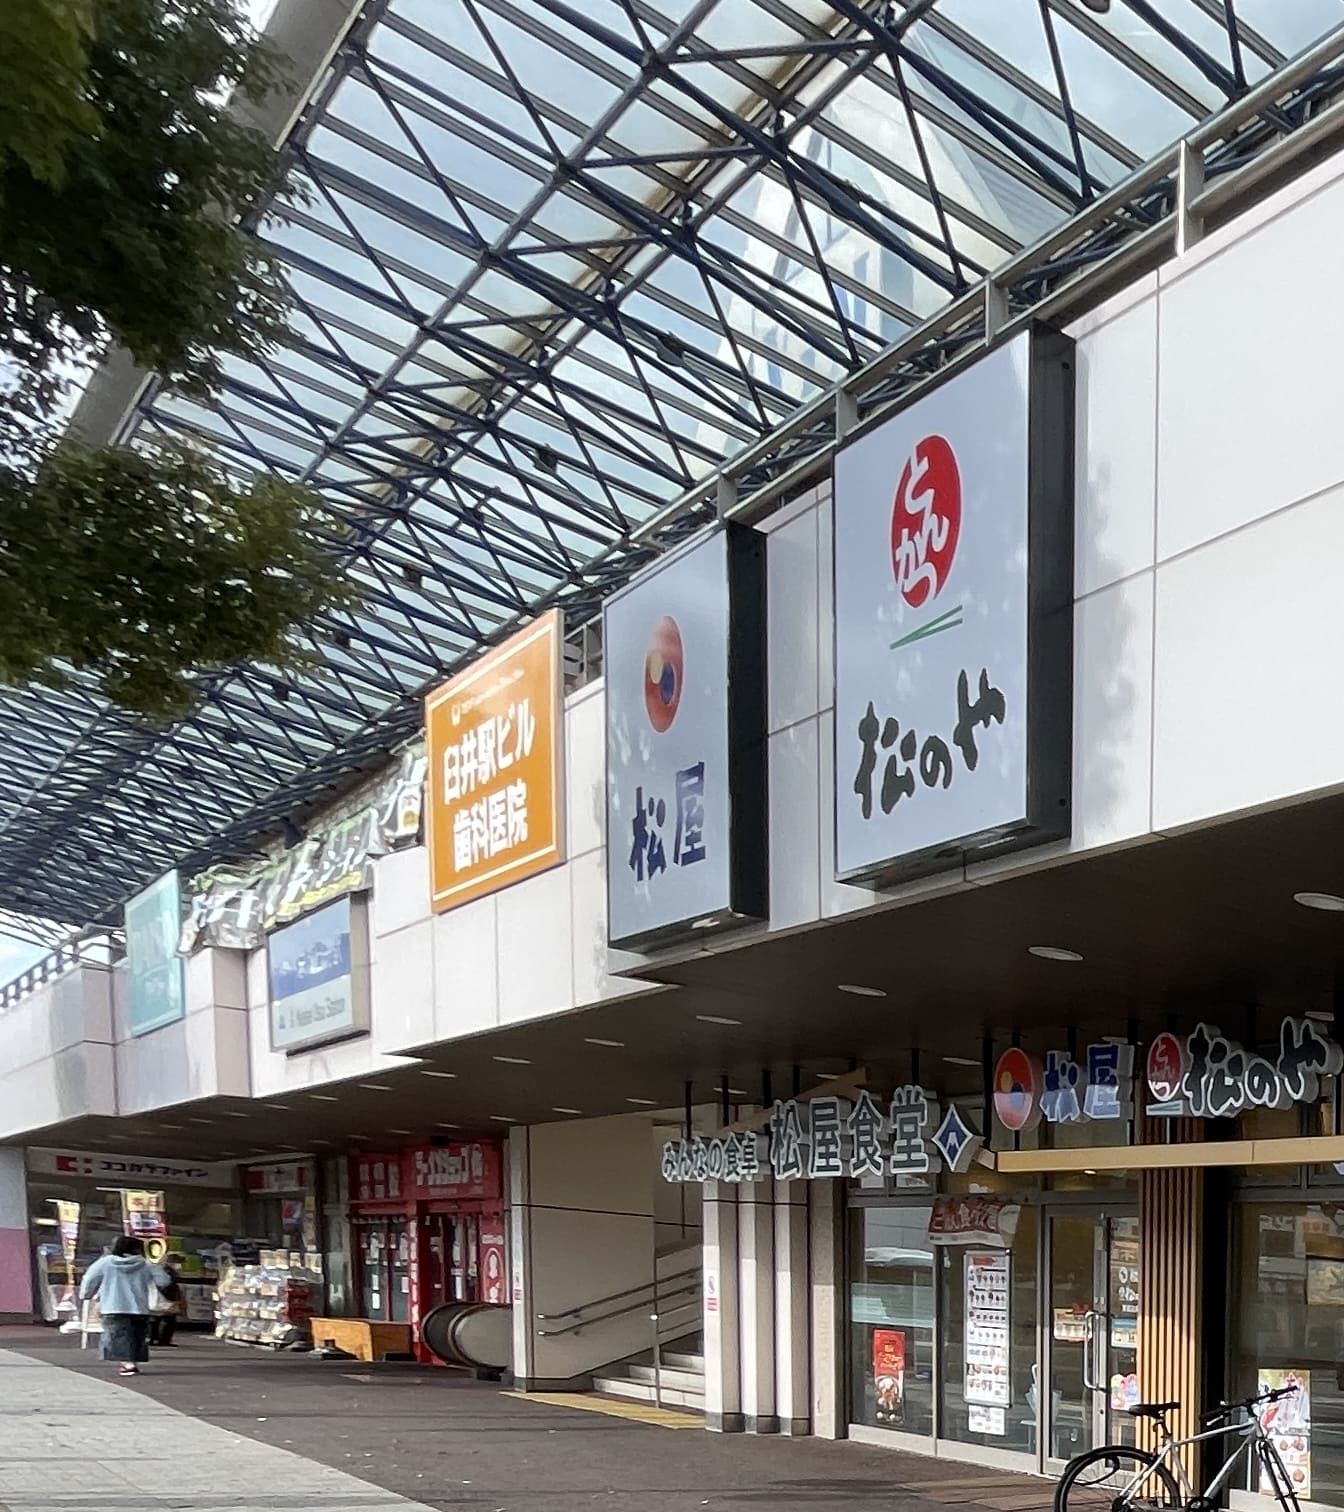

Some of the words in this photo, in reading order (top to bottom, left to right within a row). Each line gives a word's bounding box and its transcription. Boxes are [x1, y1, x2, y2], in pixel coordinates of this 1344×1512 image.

[443, 698, 536, 806] 臼井駅ビル
[853, 668, 1006, 820] 松のや
[453, 777, 529, 873] 歯科医院
[628, 761, 707, 882] 松屋
[1040, 1044, 1120, 1122] 松屋
[1182, 1016, 1328, 1117] 松のや
[662, 1131, 758, 1182] みんなの食卓
[770, 1085, 929, 1180] 松屋食堂
